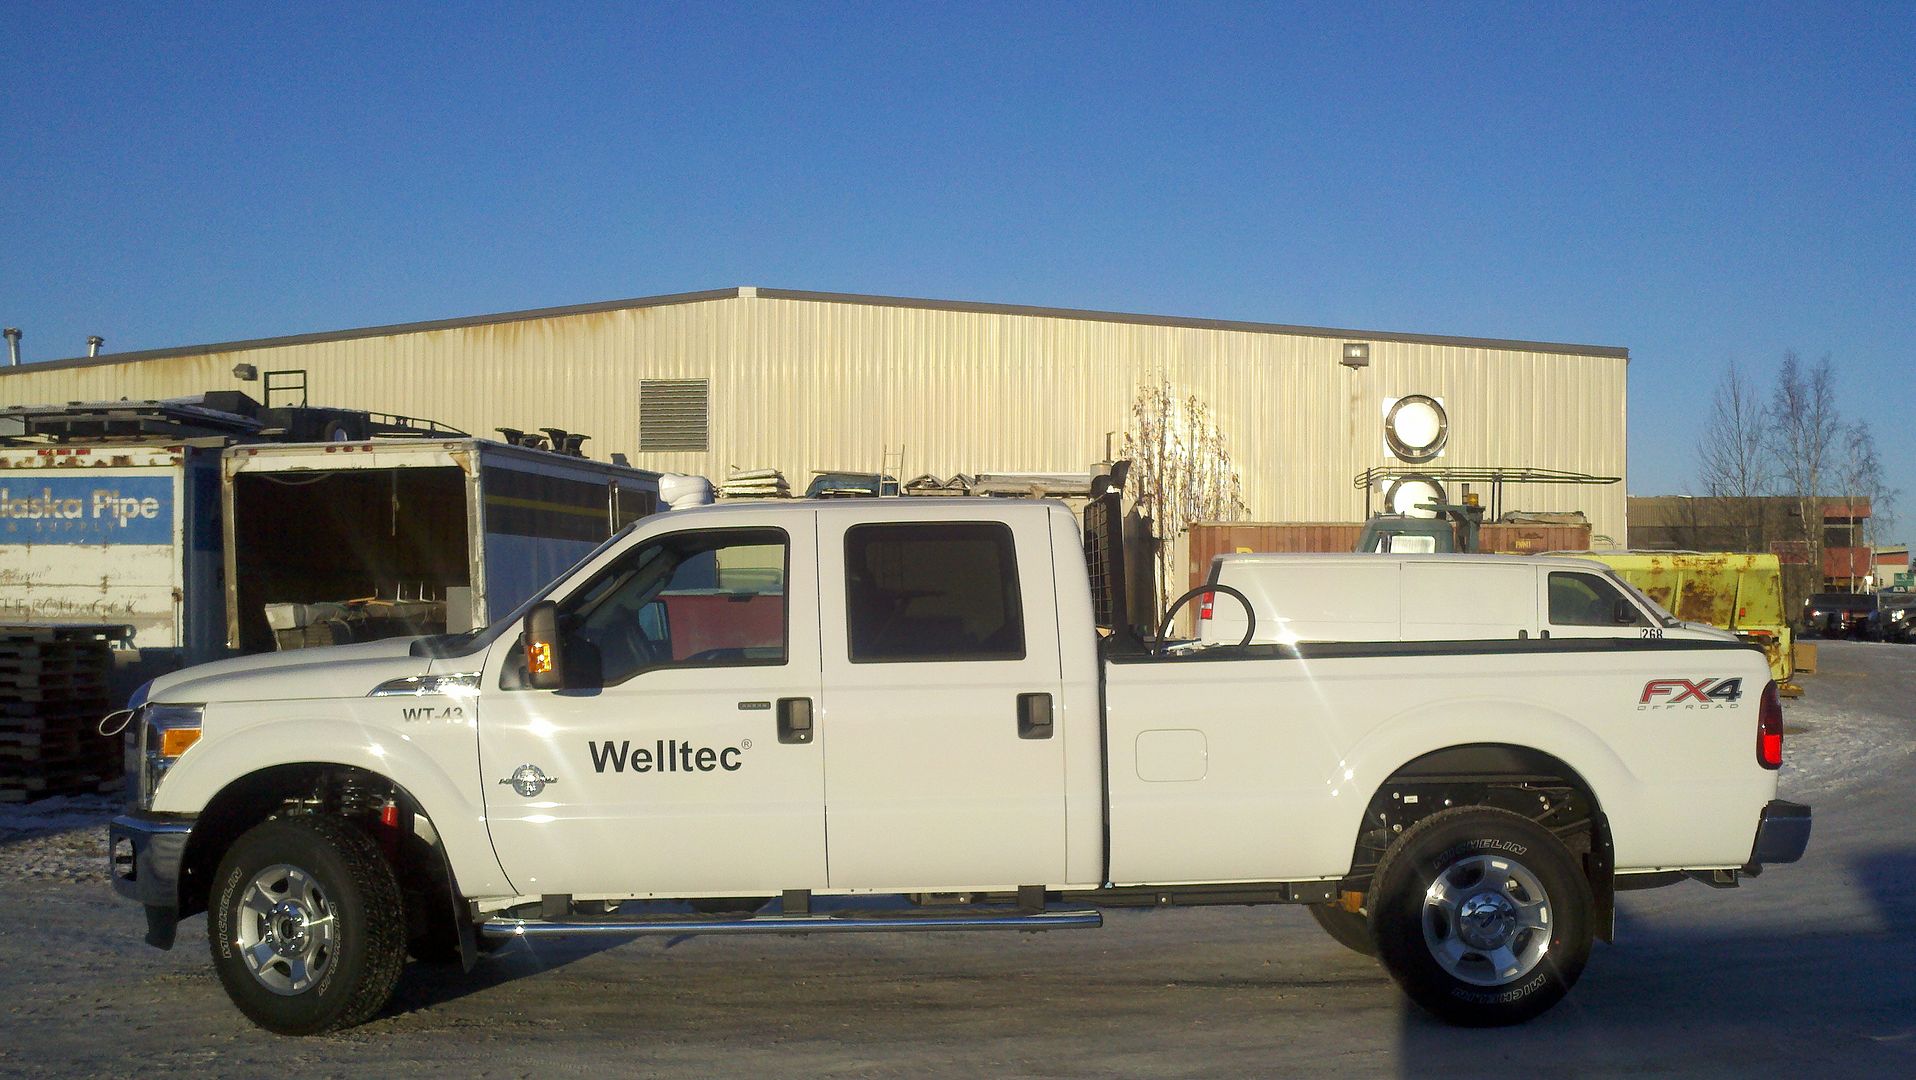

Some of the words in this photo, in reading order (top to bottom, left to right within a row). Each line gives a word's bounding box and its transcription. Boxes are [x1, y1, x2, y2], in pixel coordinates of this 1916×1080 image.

[0, 488, 83, 519] laska
[93, 488, 160, 528] Pipe
[1642, 628, 1663, 639] 268
[1639, 677, 1743, 704] FX4
[402, 707, 464, 723] WT-43
[1432, 838, 1528, 870] MIHELIN
[217, 867, 243, 958] MICHELIN
[1452, 972, 1547, 1004] MICHIN
